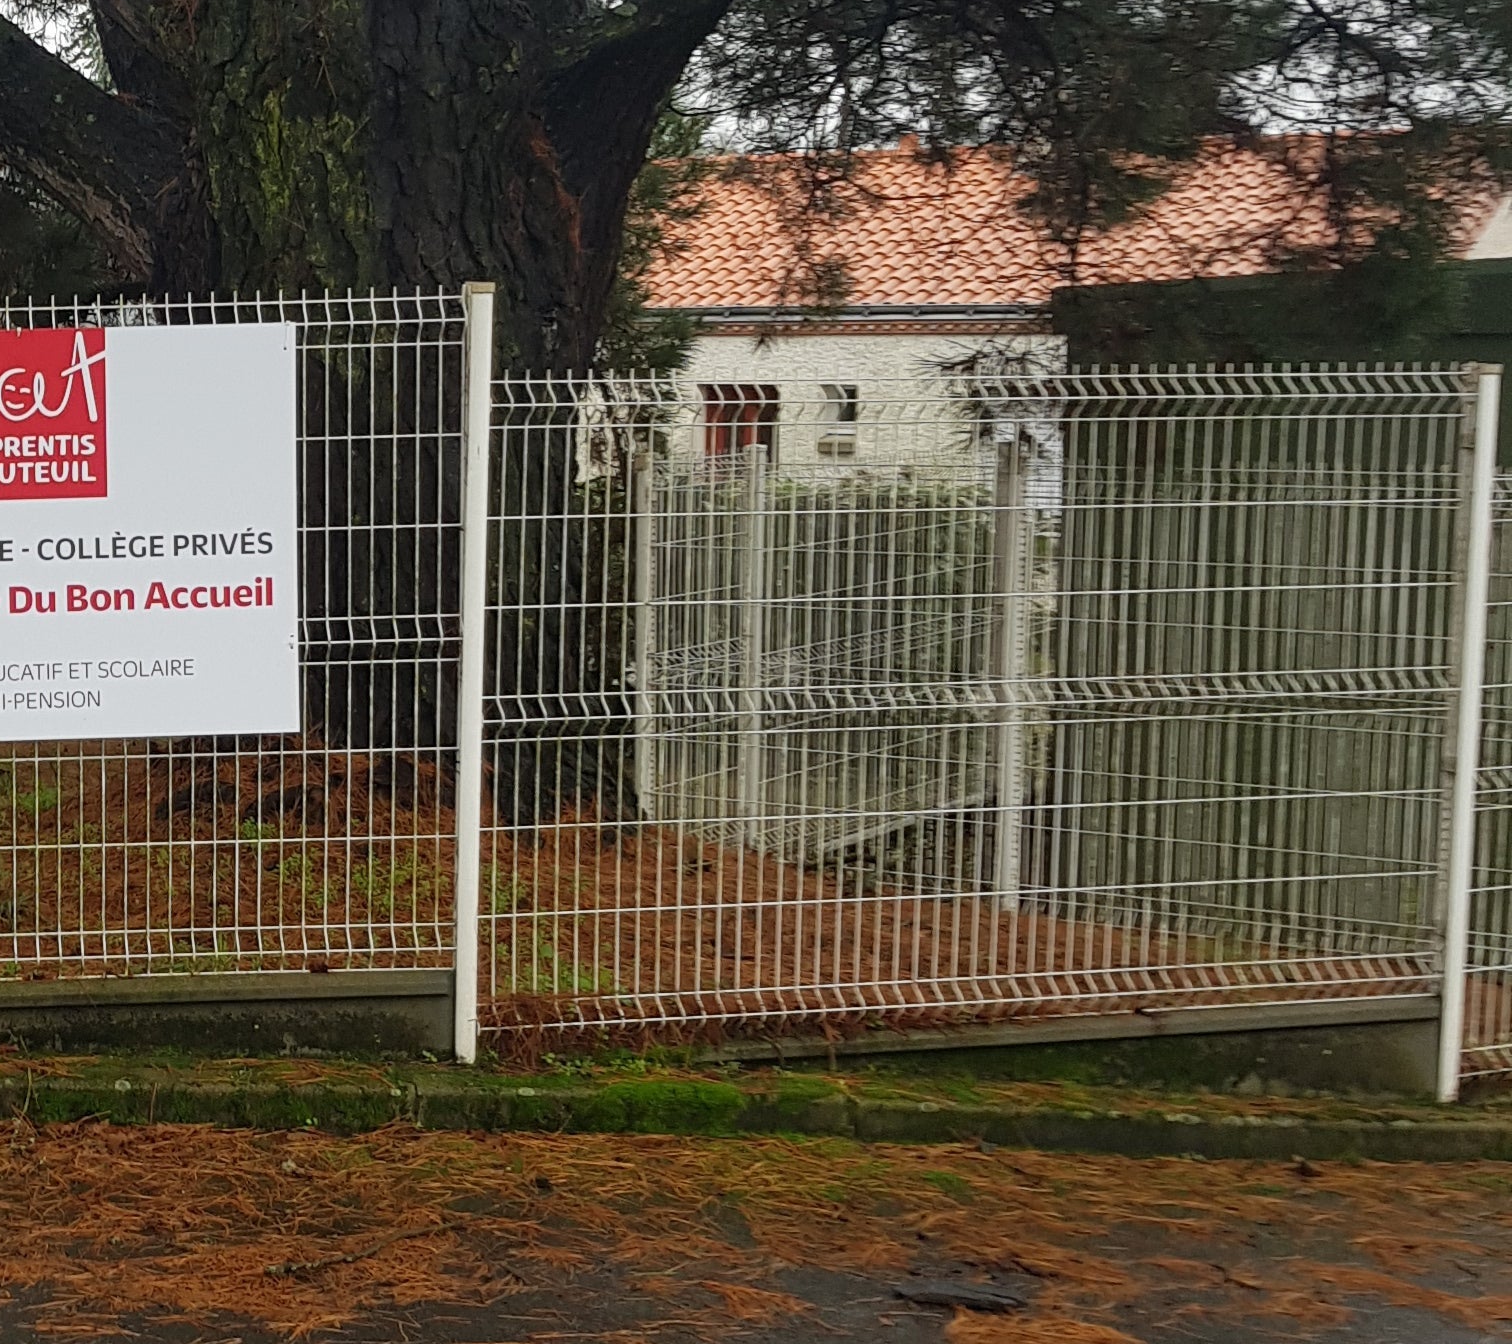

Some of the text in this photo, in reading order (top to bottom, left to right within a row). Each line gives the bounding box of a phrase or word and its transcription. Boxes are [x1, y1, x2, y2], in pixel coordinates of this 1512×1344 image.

[37, 530, 165, 561] COLLÈGE
[173, 527, 274, 556] PRIVÉS
[9, 584, 57, 614] Du
[66, 582, 135, 611] Bon
[144, 577, 274, 610] Accueil
[68, 662, 91, 680] ET
[97, 658, 194, 678] SCOLAIRE
